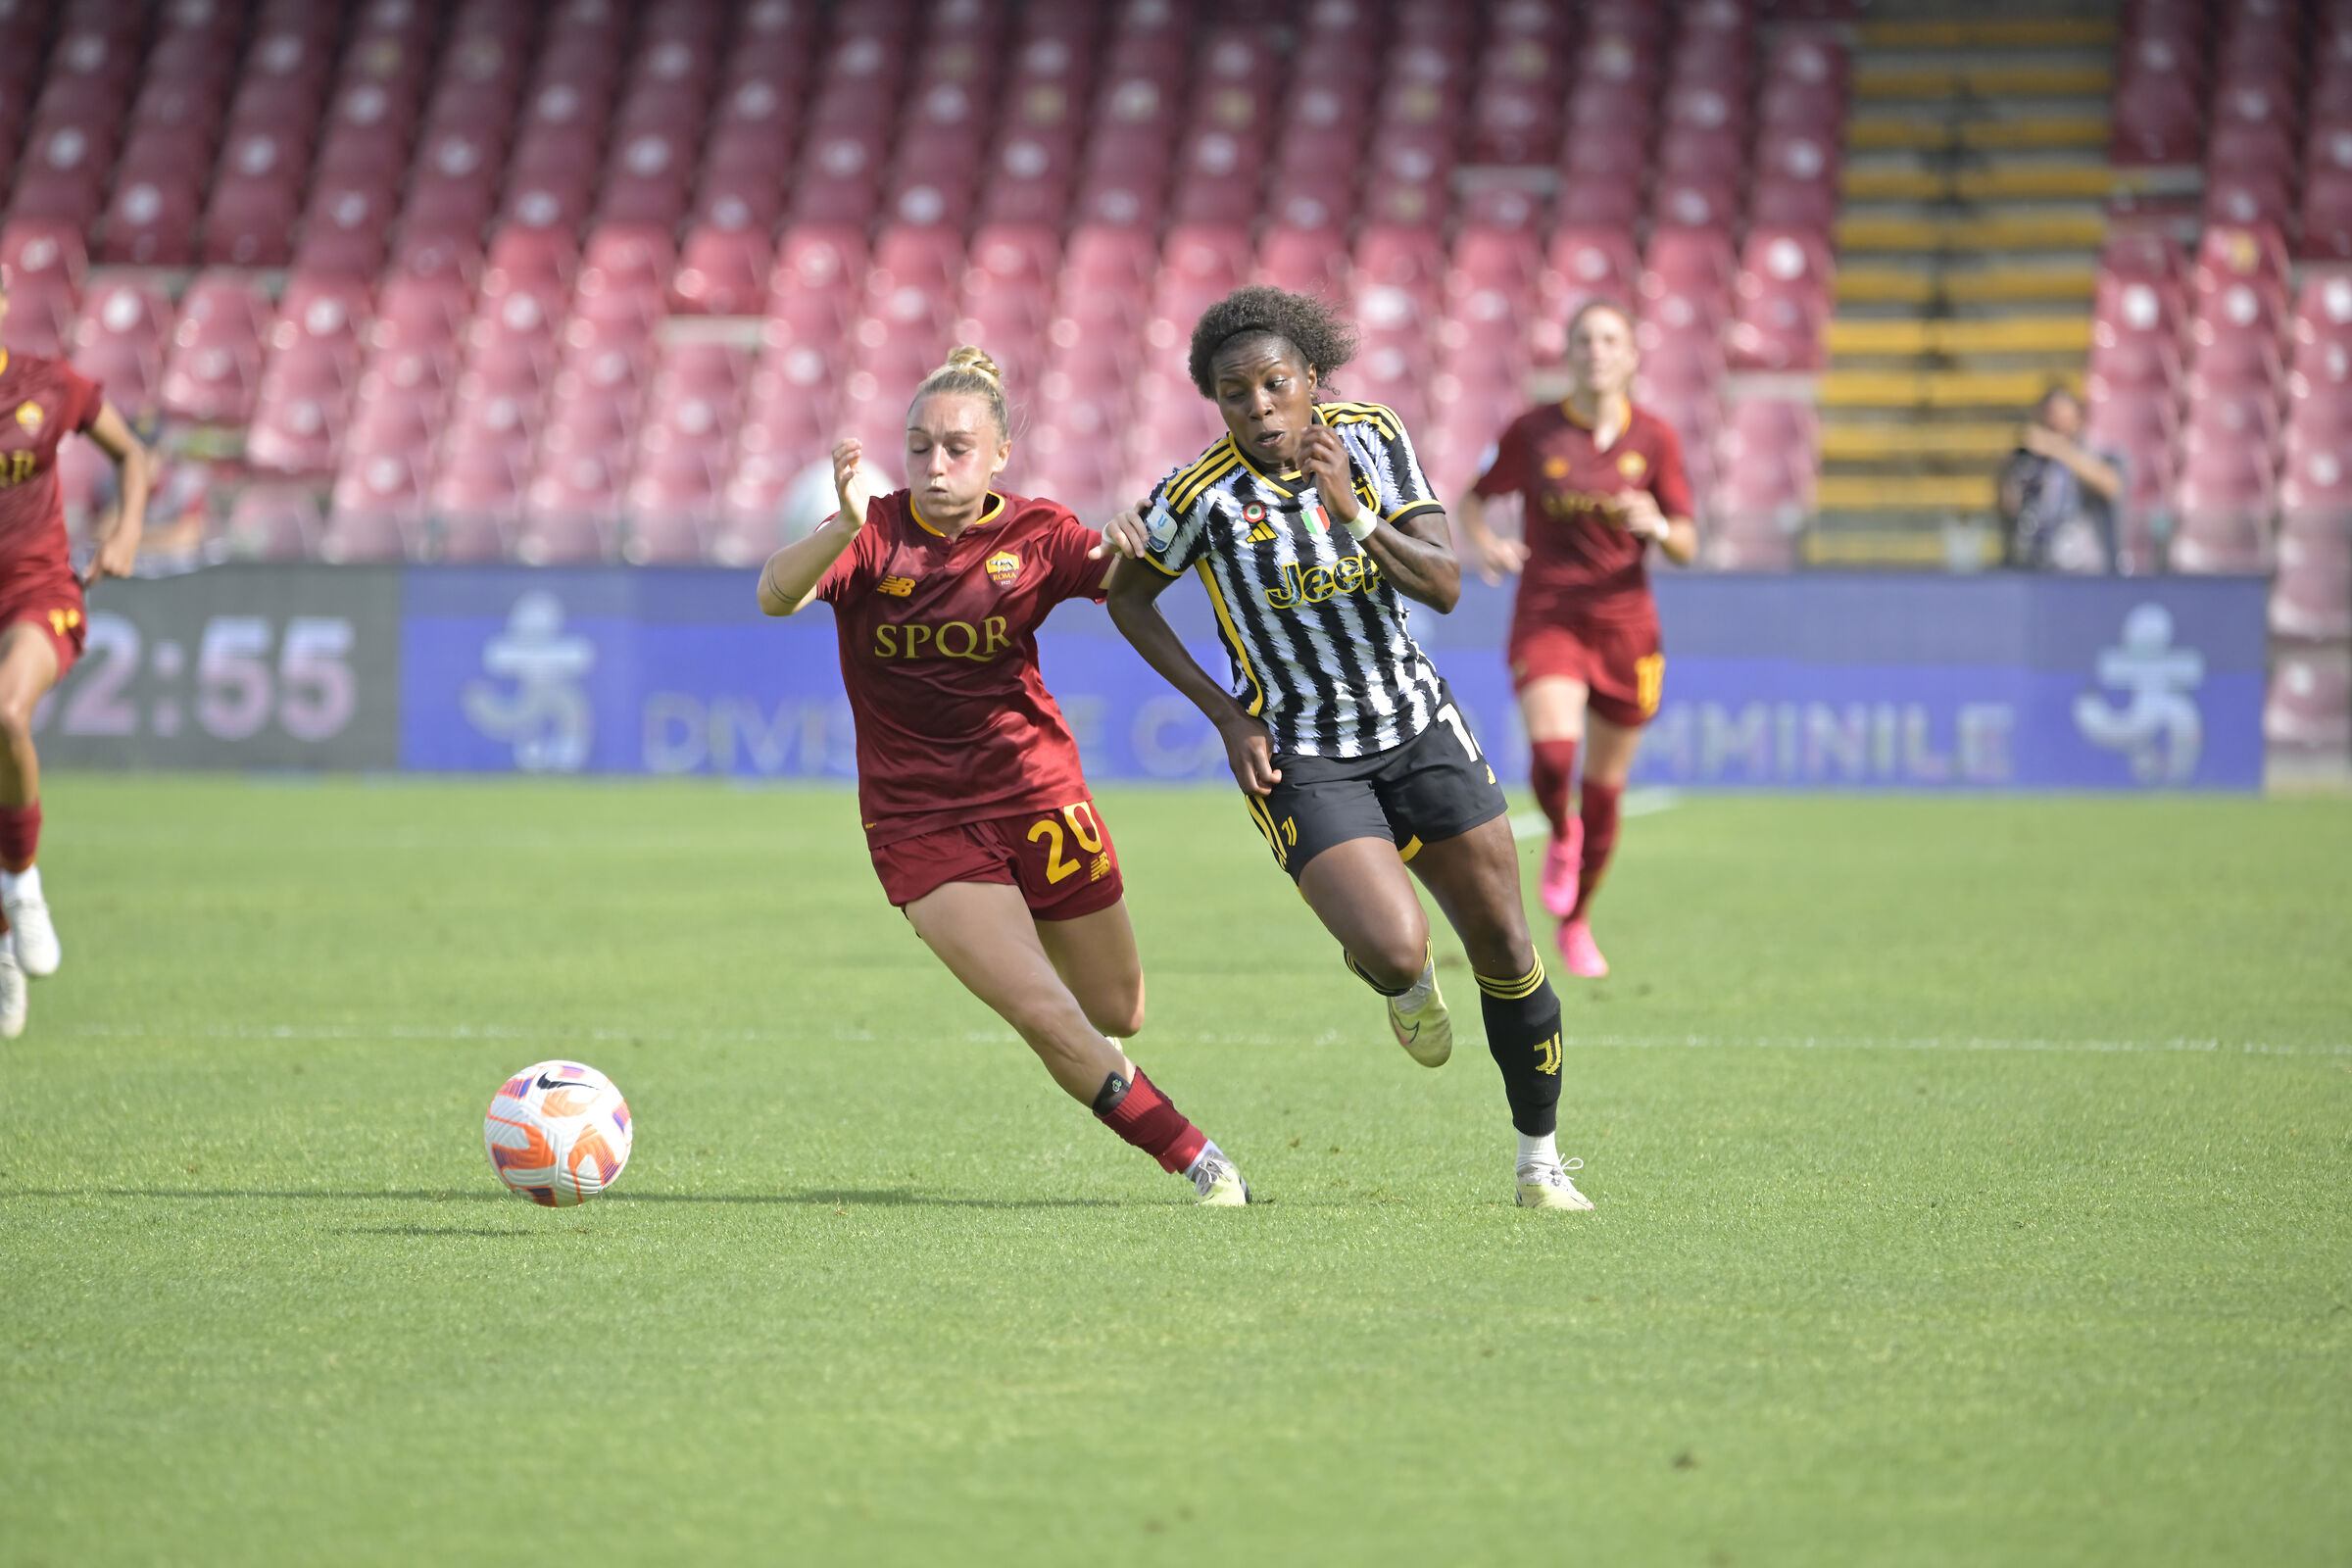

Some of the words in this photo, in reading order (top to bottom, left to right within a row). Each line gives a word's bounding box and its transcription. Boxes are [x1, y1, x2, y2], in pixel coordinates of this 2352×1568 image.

[993, 571, 1017, 581] ROMA
[1265, 553, 1385, 609] Jeep
[874, 615, 1012, 662] SPQR
[33, 611, 356, 742] 2:55
[1027, 801, 1102, 885] 20
